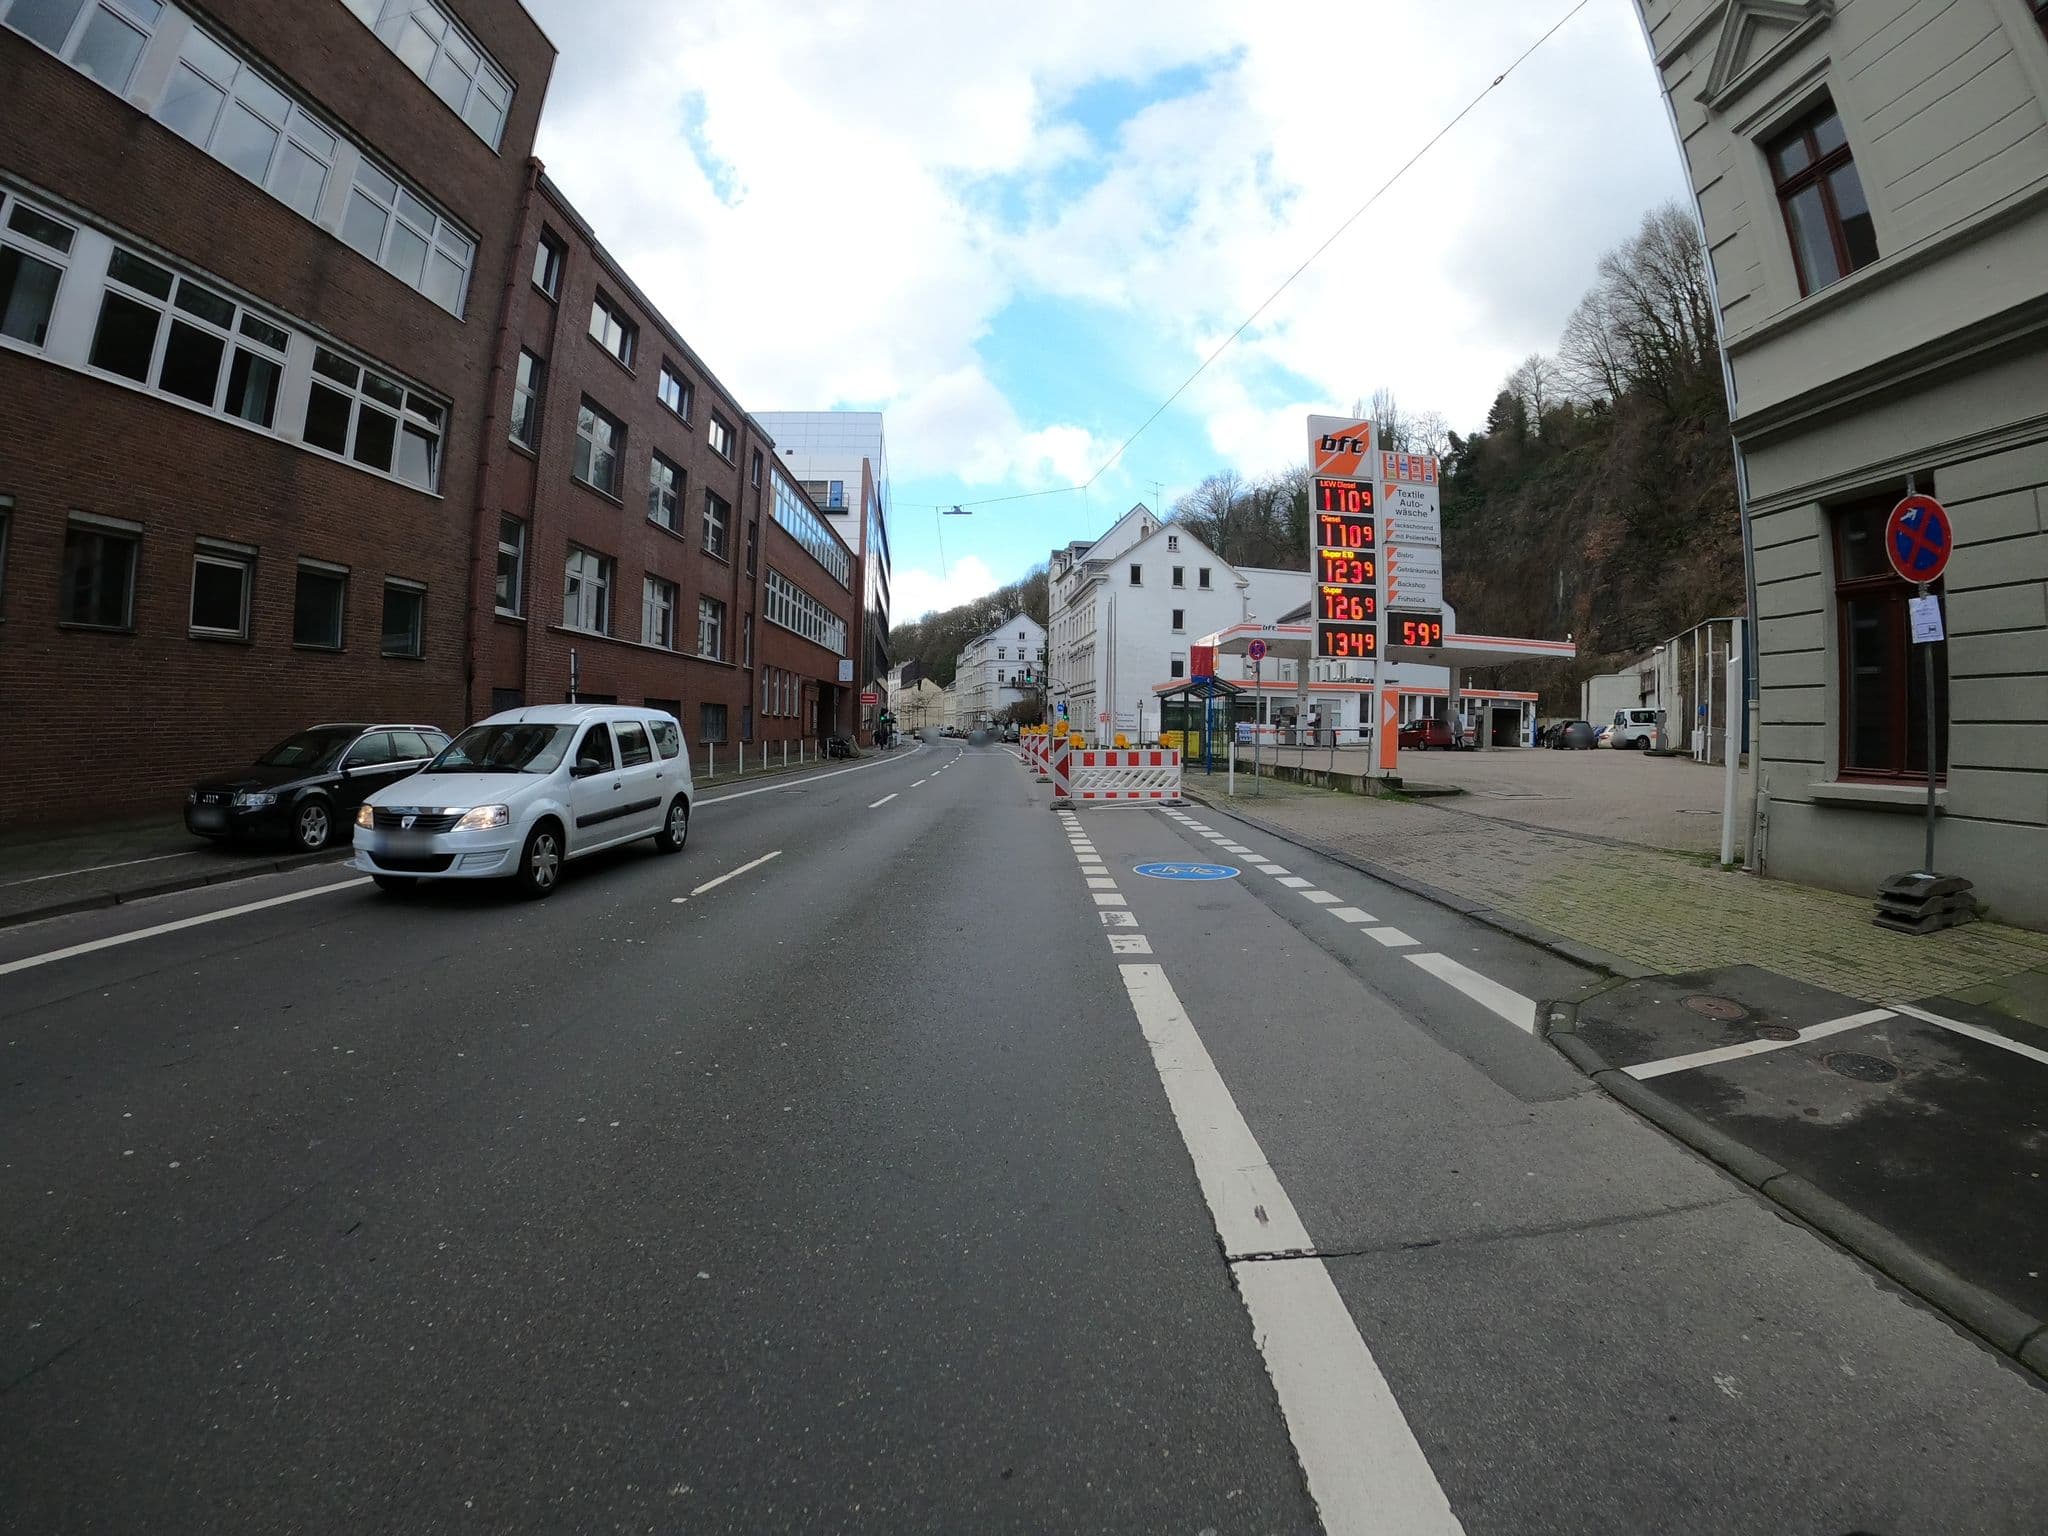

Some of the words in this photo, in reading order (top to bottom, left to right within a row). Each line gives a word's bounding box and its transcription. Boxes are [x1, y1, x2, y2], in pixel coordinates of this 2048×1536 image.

[1321, 434, 1364, 455] bft
[1320, 480, 1336, 488] LKW
[1397, 489, 1425, 499] Textile
[1400, 499, 1423, 508] Auto-
[1395, 508, 1428, 518] wäsche
[1321, 515, 1341, 523] Diesel
[1322, 550, 1341, 559] Super
[1342, 551, 1354, 559] E10
[1397, 581, 1426, 589] Backshop
[1323, 586, 1342, 595] Super
[1397, 595, 1426, 603] Frühstück
